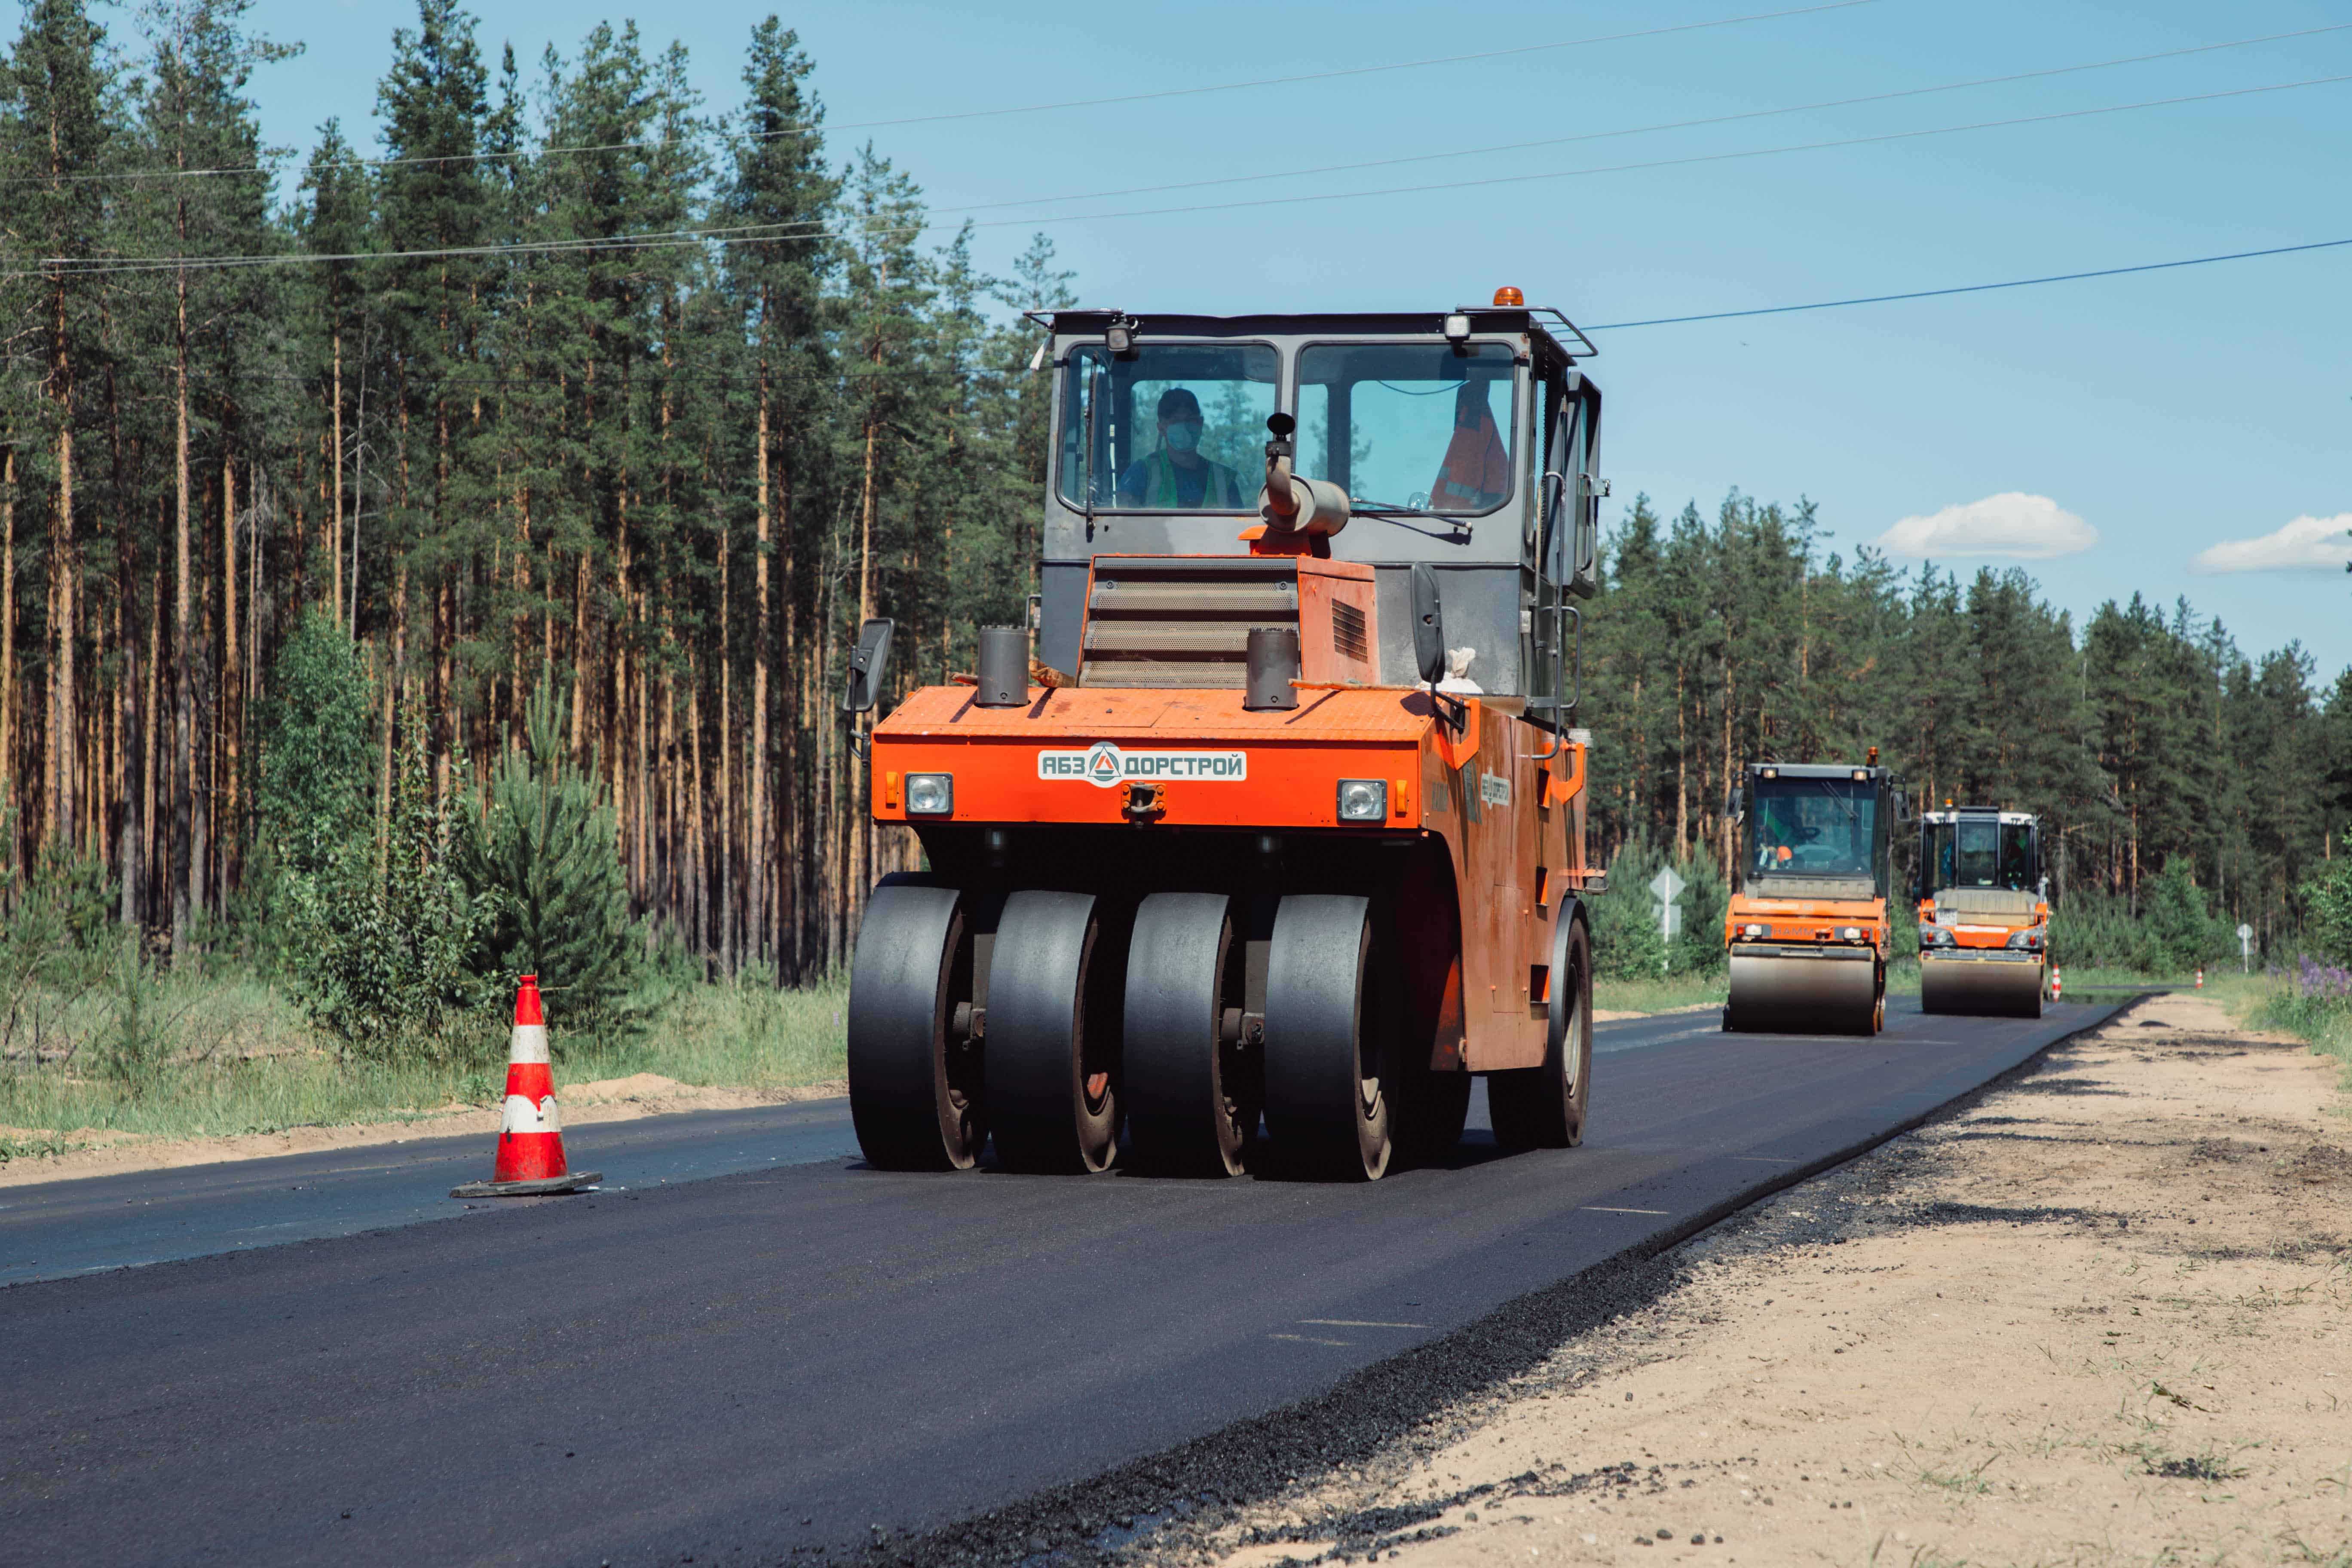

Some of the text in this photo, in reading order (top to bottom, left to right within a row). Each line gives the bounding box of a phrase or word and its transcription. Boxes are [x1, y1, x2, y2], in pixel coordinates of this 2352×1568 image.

[1043, 753, 1242, 775] АБЗ ДОРСТРОЙ
[1773, 927, 1814, 936] HAMM
